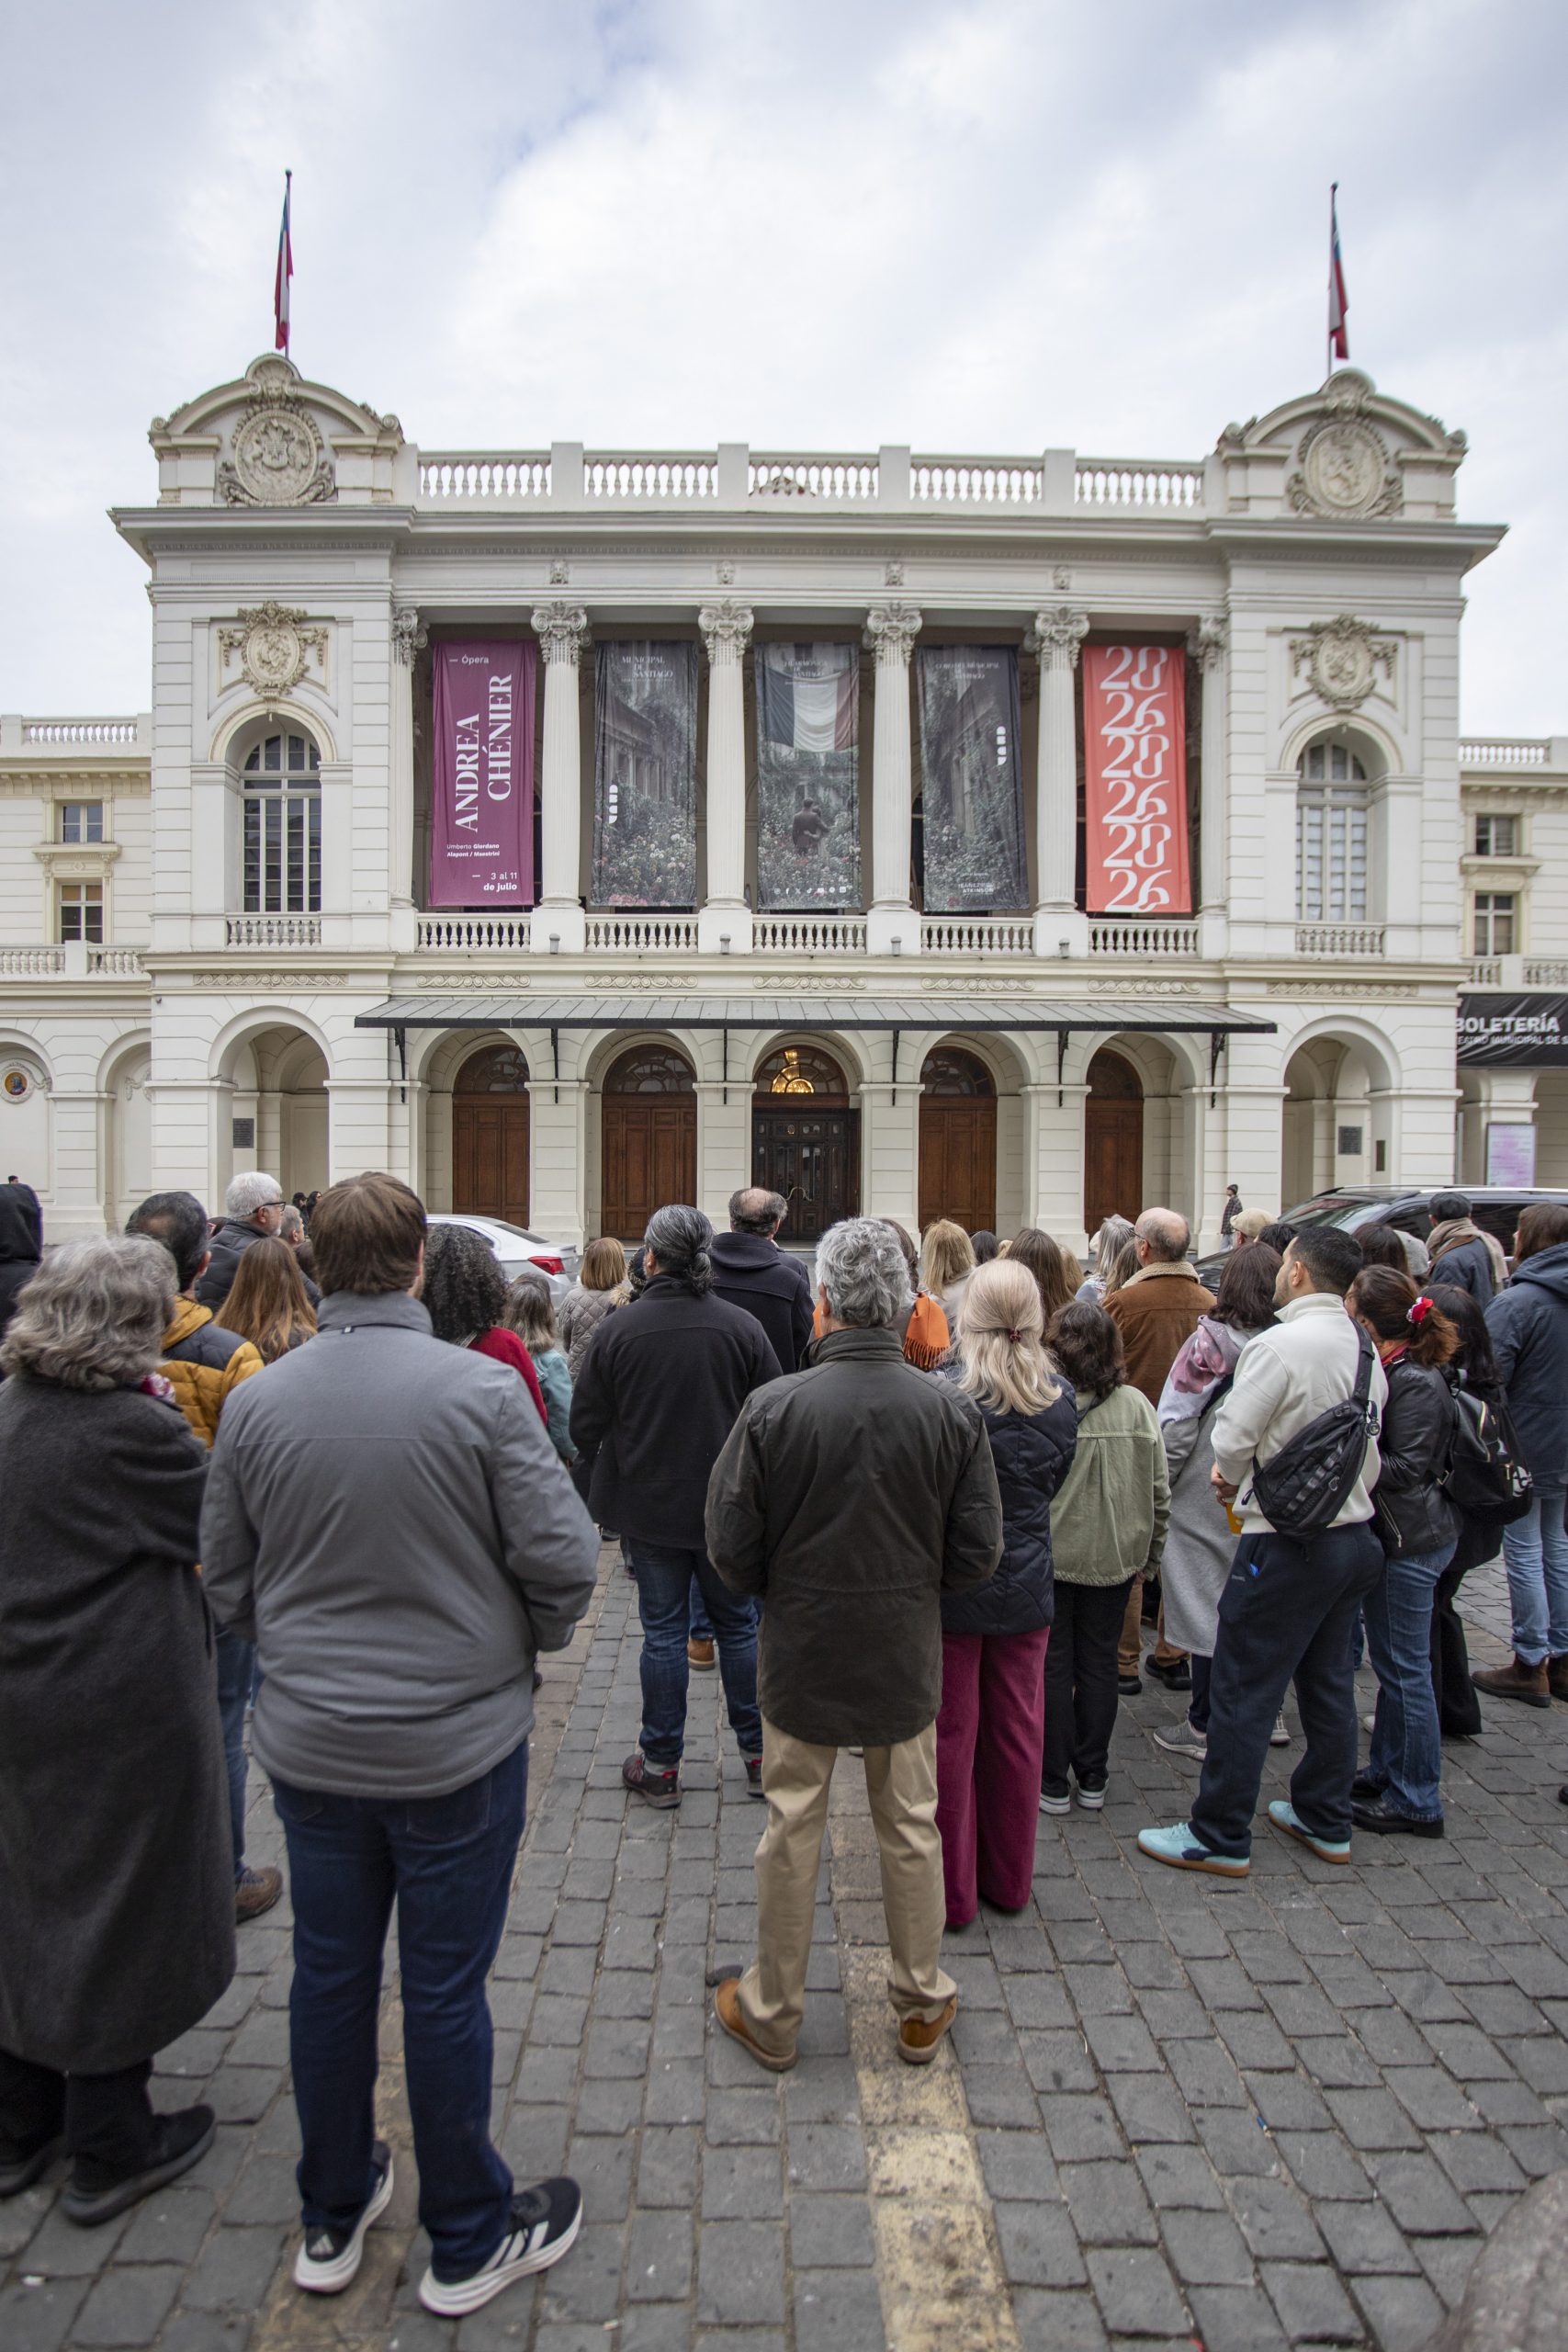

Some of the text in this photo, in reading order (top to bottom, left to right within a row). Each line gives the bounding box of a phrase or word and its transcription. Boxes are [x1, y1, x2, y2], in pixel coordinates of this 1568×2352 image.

[461, 653, 490, 665] Ópera
[632, 670, 673, 678] SANTIAGO
[1100, 646, 1168, 690] 20
[1100, 691, 1168, 735] 26
[482, 673, 512, 801] CHÉNIER
[1101, 734, 1169, 779] 20
[455, 713, 479, 833] ANDREA
[1102, 780, 1170, 824] 26
[1103, 822, 1172, 868] 20
[483, 882, 517, 892] de julio
[491, 872, 496, 880] 3
[499, 872, 507, 880] al
[1104, 868, 1172, 912] 26
[1455, 1012, 1560, 1033] BOLETERÍA
[1458, 1035, 1488, 1045] EATRO
[1490, 1035, 1543, 1045] MUNICIPAL
[1546, 1035, 1560, 1045] DE
